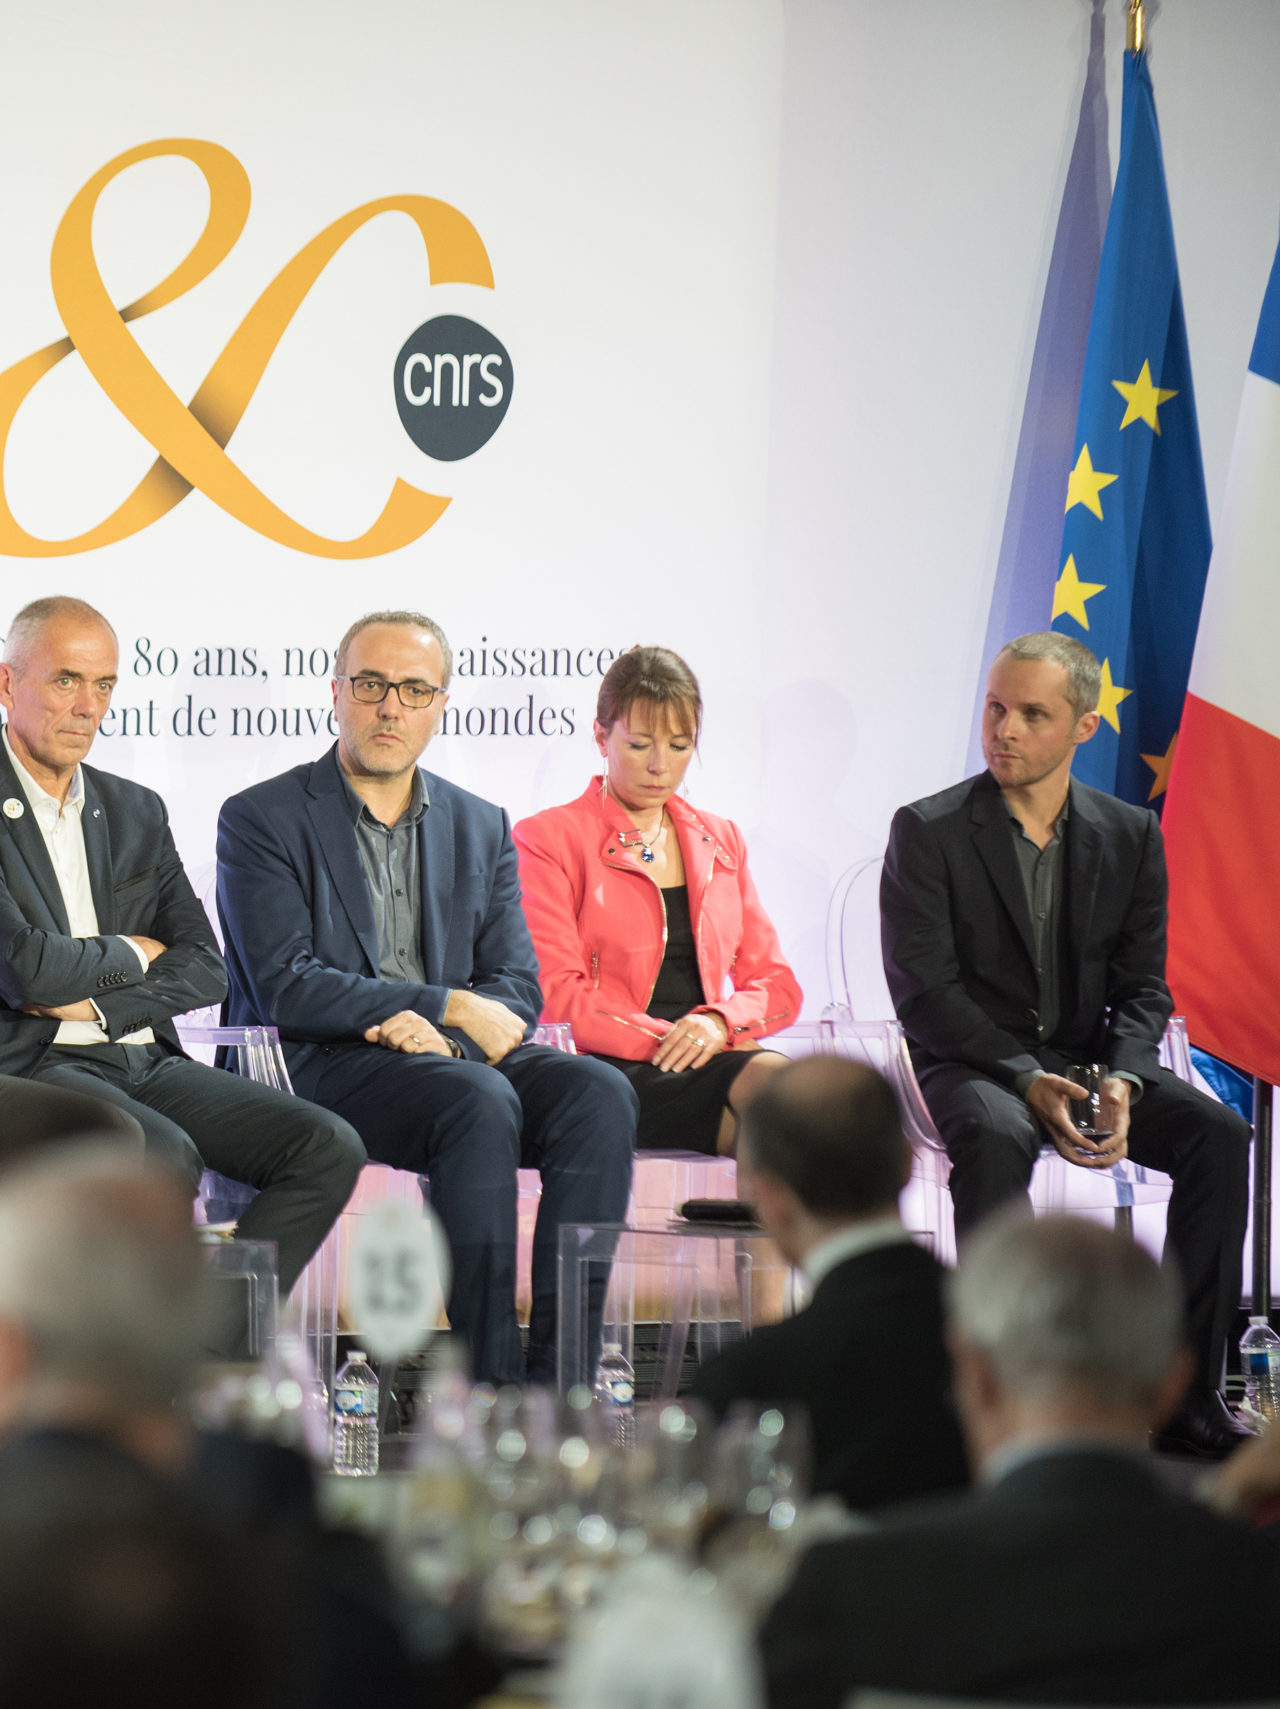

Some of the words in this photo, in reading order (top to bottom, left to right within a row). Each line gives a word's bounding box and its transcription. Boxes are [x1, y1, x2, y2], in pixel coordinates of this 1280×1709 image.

[404, 353, 504, 407] cnrs
[133, 637, 179, 677] 80
[193, 646, 268, 684] ans,
[282, 646, 338, 678] no
[173, 695, 217, 737] de
[230, 704, 339, 737] nouve
